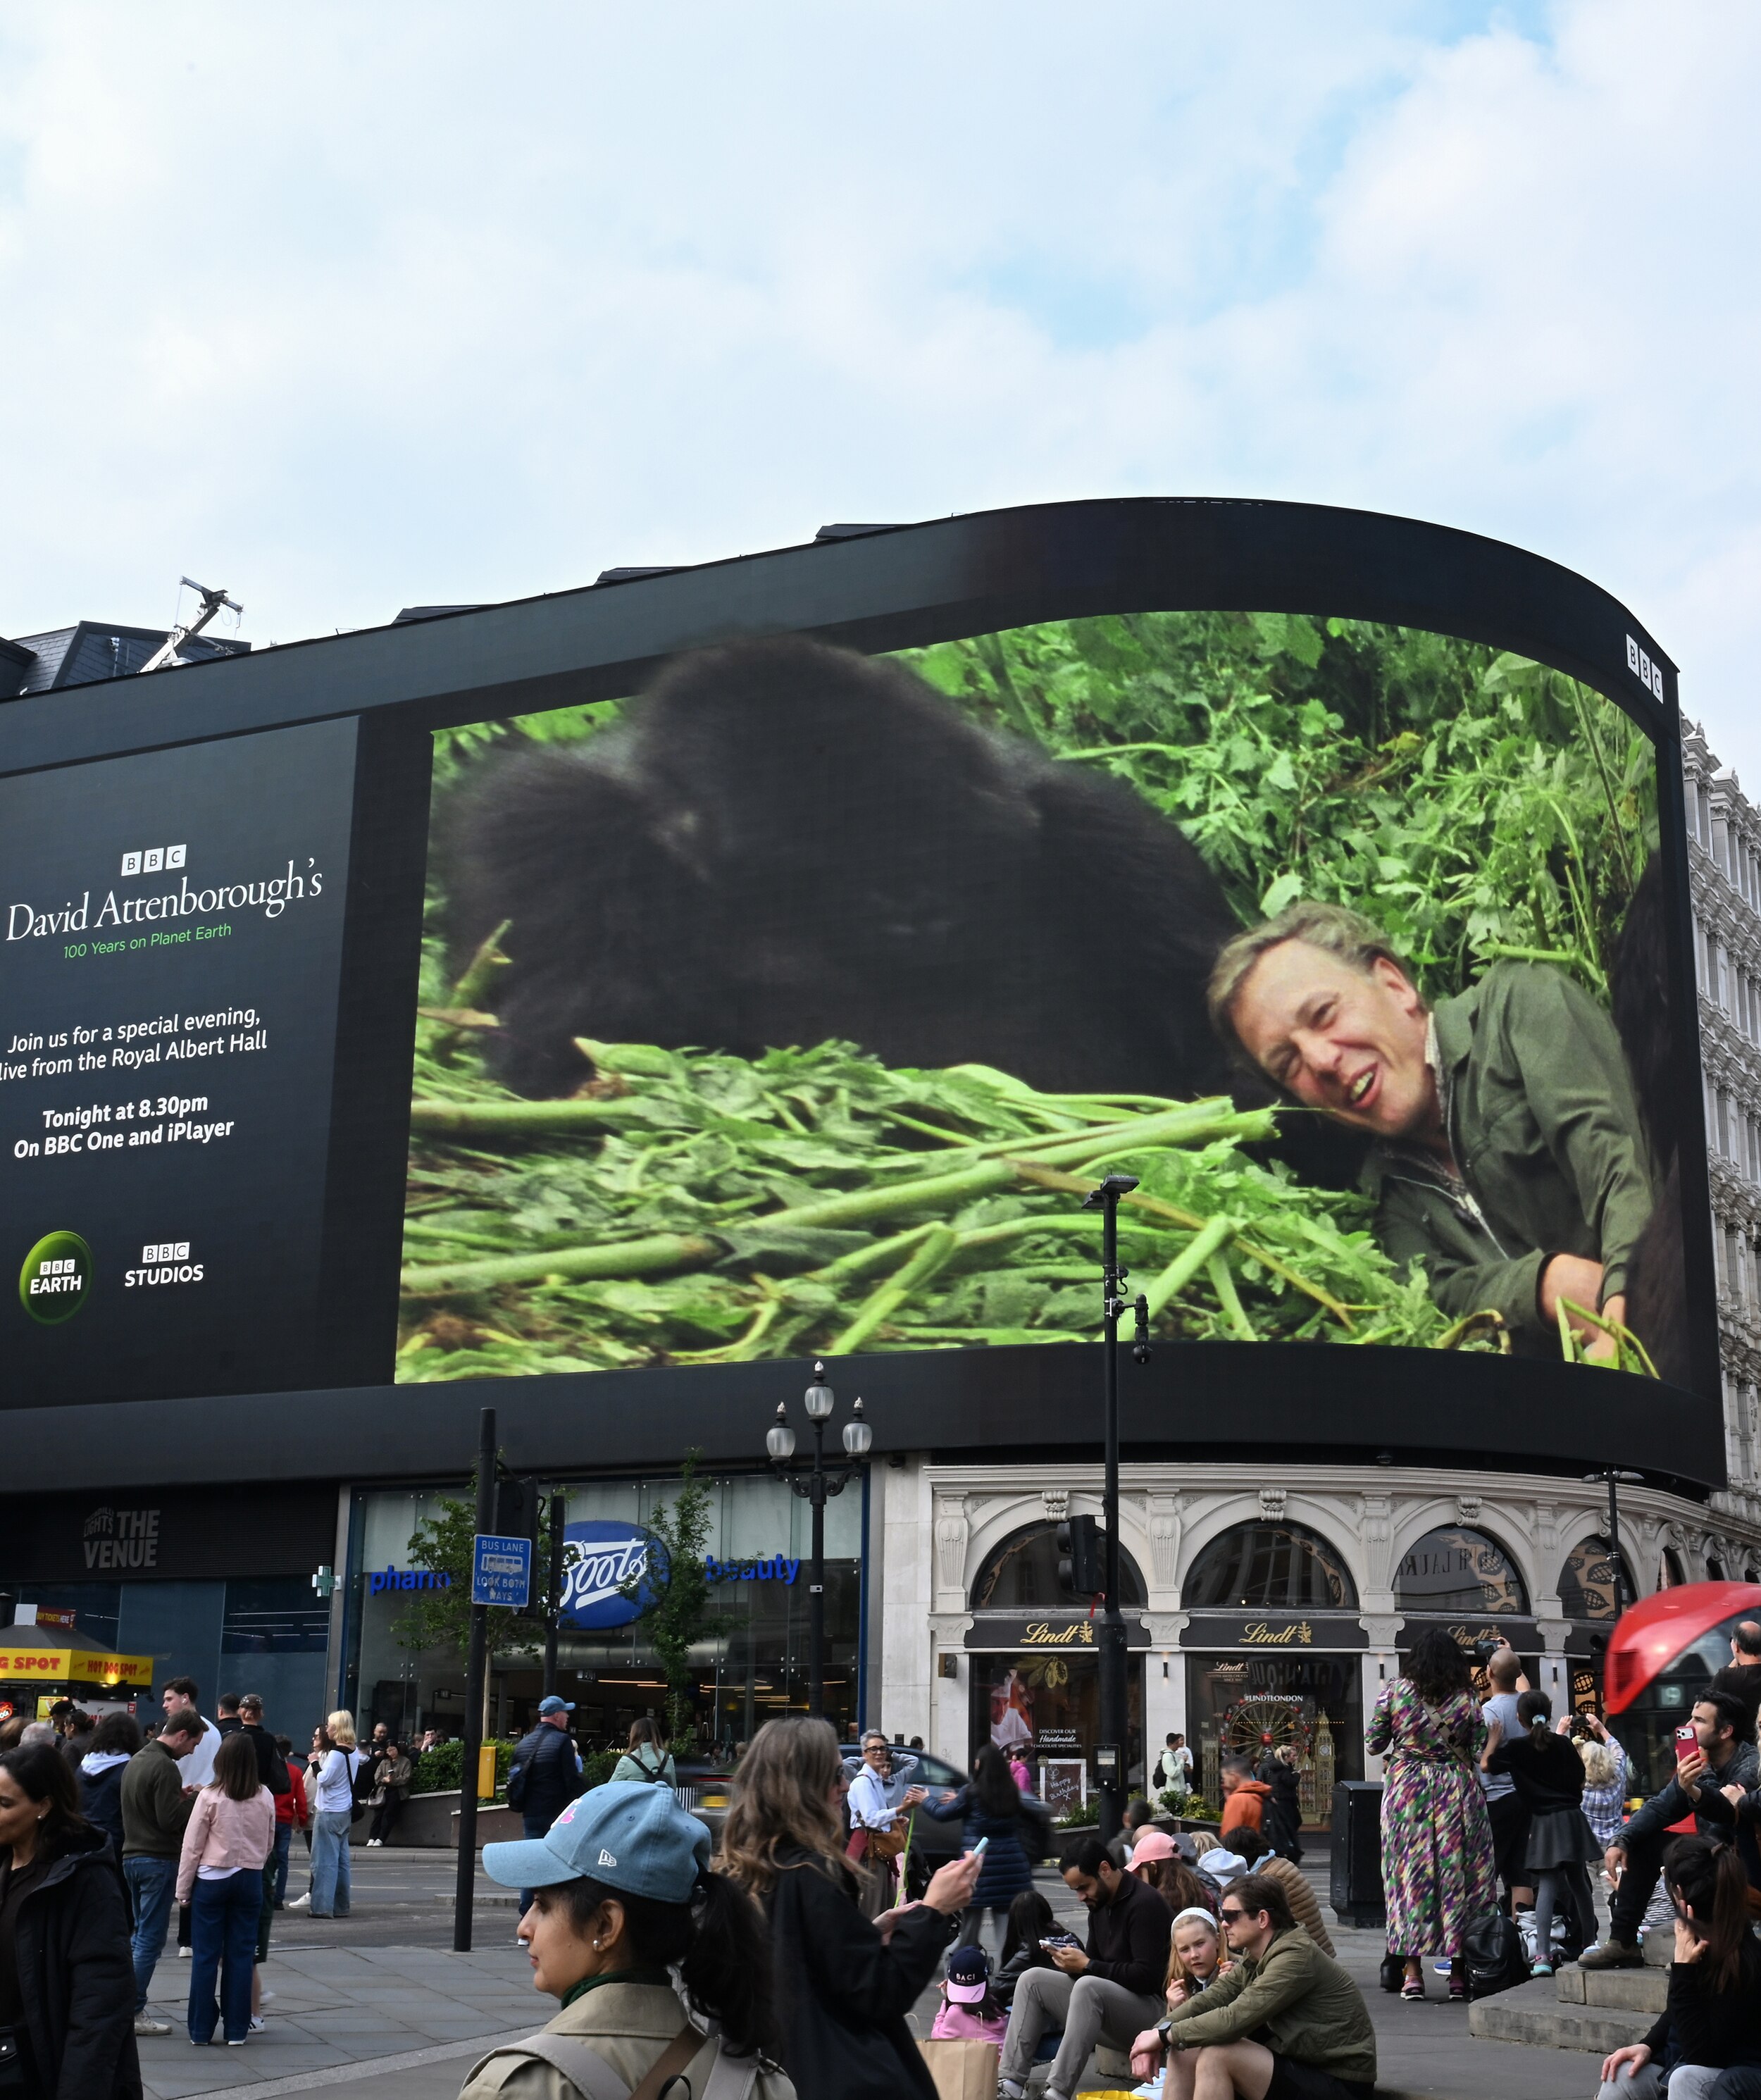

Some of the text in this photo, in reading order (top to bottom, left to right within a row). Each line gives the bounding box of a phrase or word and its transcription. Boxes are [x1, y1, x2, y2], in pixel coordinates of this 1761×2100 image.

[1628, 639, 1662, 699] BBC
[125, 847, 183, 873] BBC
[6, 892, 89, 940] David
[63, 924, 232, 958] 100 Years on Planet Earth
[8, 1007, 261, 1053] Join us for a special evening,
[0, 1030, 268, 1081] live from the Royal Albert Hall
[43, 1095, 208, 1129] Tonight at 8.30pm
[14, 1120, 234, 1159] On BBC One and iPlayer
[144, 1243, 188, 1262] BBC
[42, 1260, 74, 1274] BBC
[125, 1265, 204, 1287] STUDIOS
[30, 1276, 82, 1294] EARTH
[84, 1515, 113, 1538] LIGHTS
[117, 1510, 161, 1539] THE
[83, 1539, 158, 1569] VENUE
[482, 1540, 524, 1553] BUS LANE
[557, 1538, 648, 1609] Boots
[706, 1553, 800, 1585] beauty
[370, 1565, 452, 1596] pharm
[477, 1577, 525, 1589] LOOK BOTH
[1020, 1622, 1079, 1644] Lindt
[1238, 1622, 1297, 1644] Lindt
[13, 1656, 61, 1670] SPOT
[87, 1660, 138, 1676] HOT DOG SPOT
[1212, 1661, 1245, 1672] Lindt
[1039, 1734, 1076, 1743] Handmade
[1049, 1782, 1080, 1800] Birthday
[1050, 1777, 1071, 1789] Happy
[956, 1972, 976, 1981] BACI
